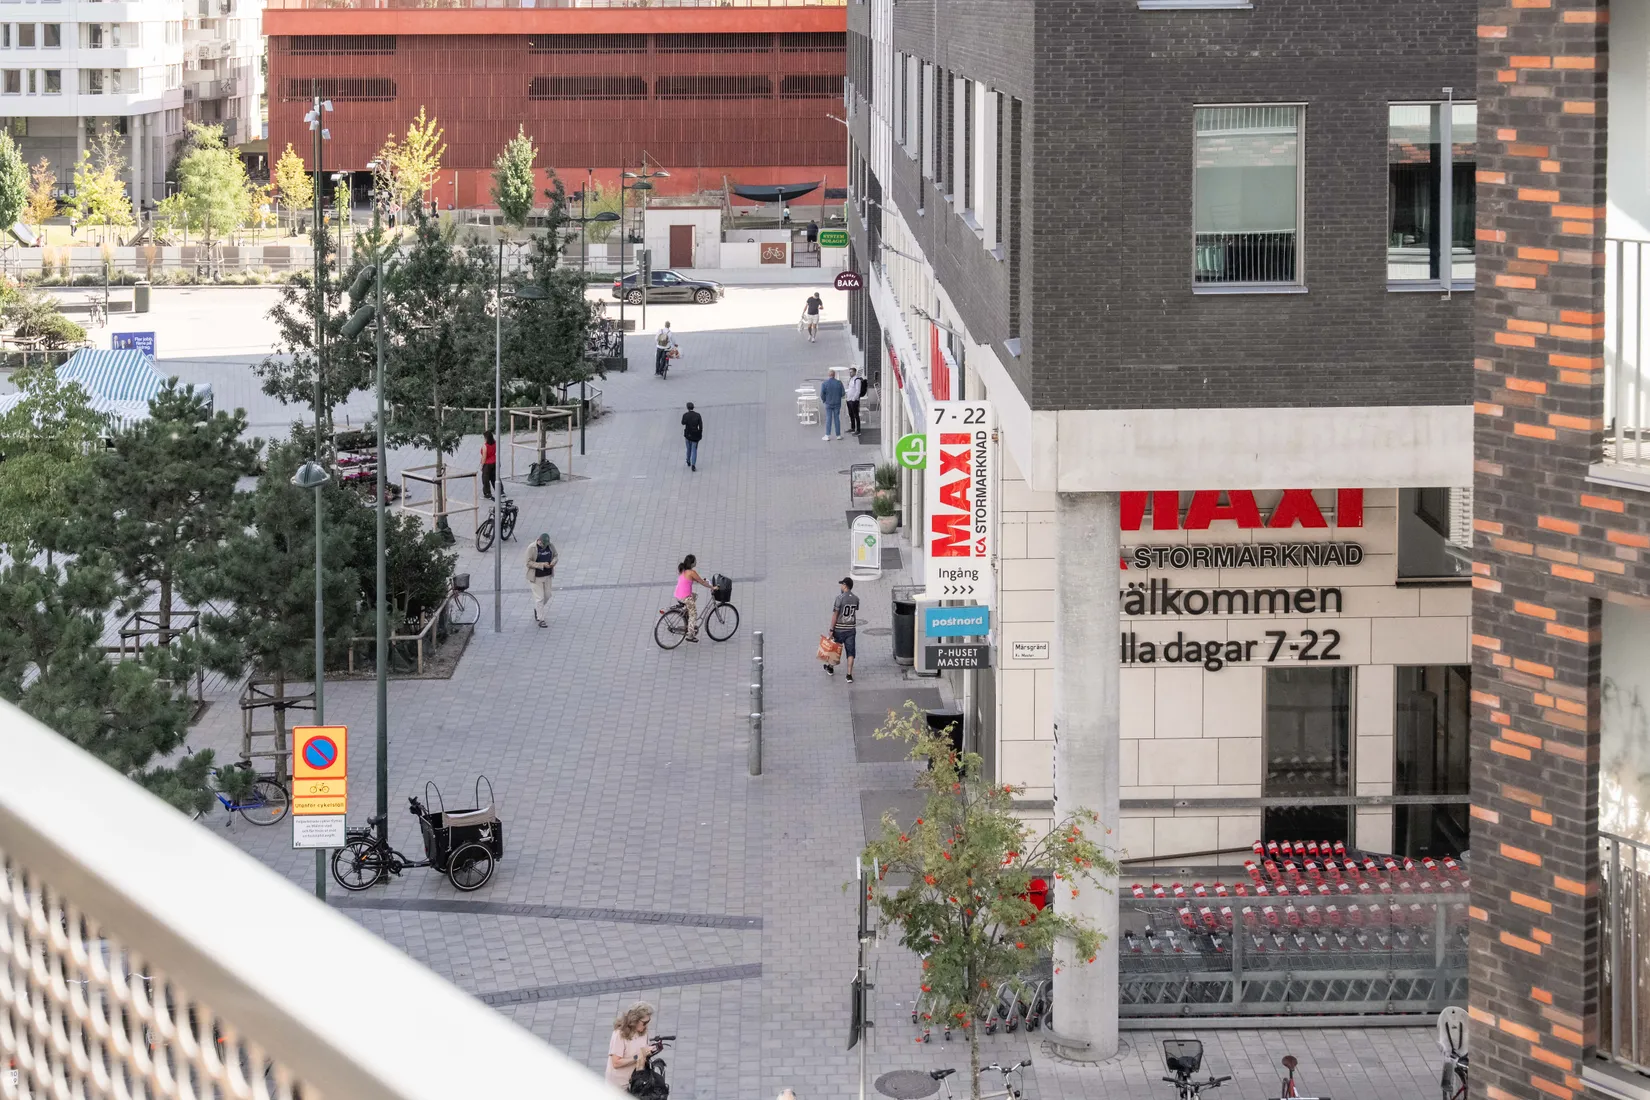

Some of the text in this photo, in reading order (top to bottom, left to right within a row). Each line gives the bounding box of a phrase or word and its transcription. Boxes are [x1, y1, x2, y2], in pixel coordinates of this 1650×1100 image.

[934, 408, 945, 425] 7
[963, 408, 986, 424] 22
[932, 433, 971, 557] MAXI
[975, 430, 987, 557] ICA STORMARKNAD
[1134, 543, 1365, 570] STORMARKNAD
[938, 567, 979, 581] Ingång
[1120, 578, 1342, 616] älkommen
[932, 616, 983, 628] postnord
[938, 648, 978, 657] P-HUSET
[1163, 631, 1258, 672] dagar
[1265, 629, 1341, 662] 7-22
[937, 658, 978, 667] MASTEN
